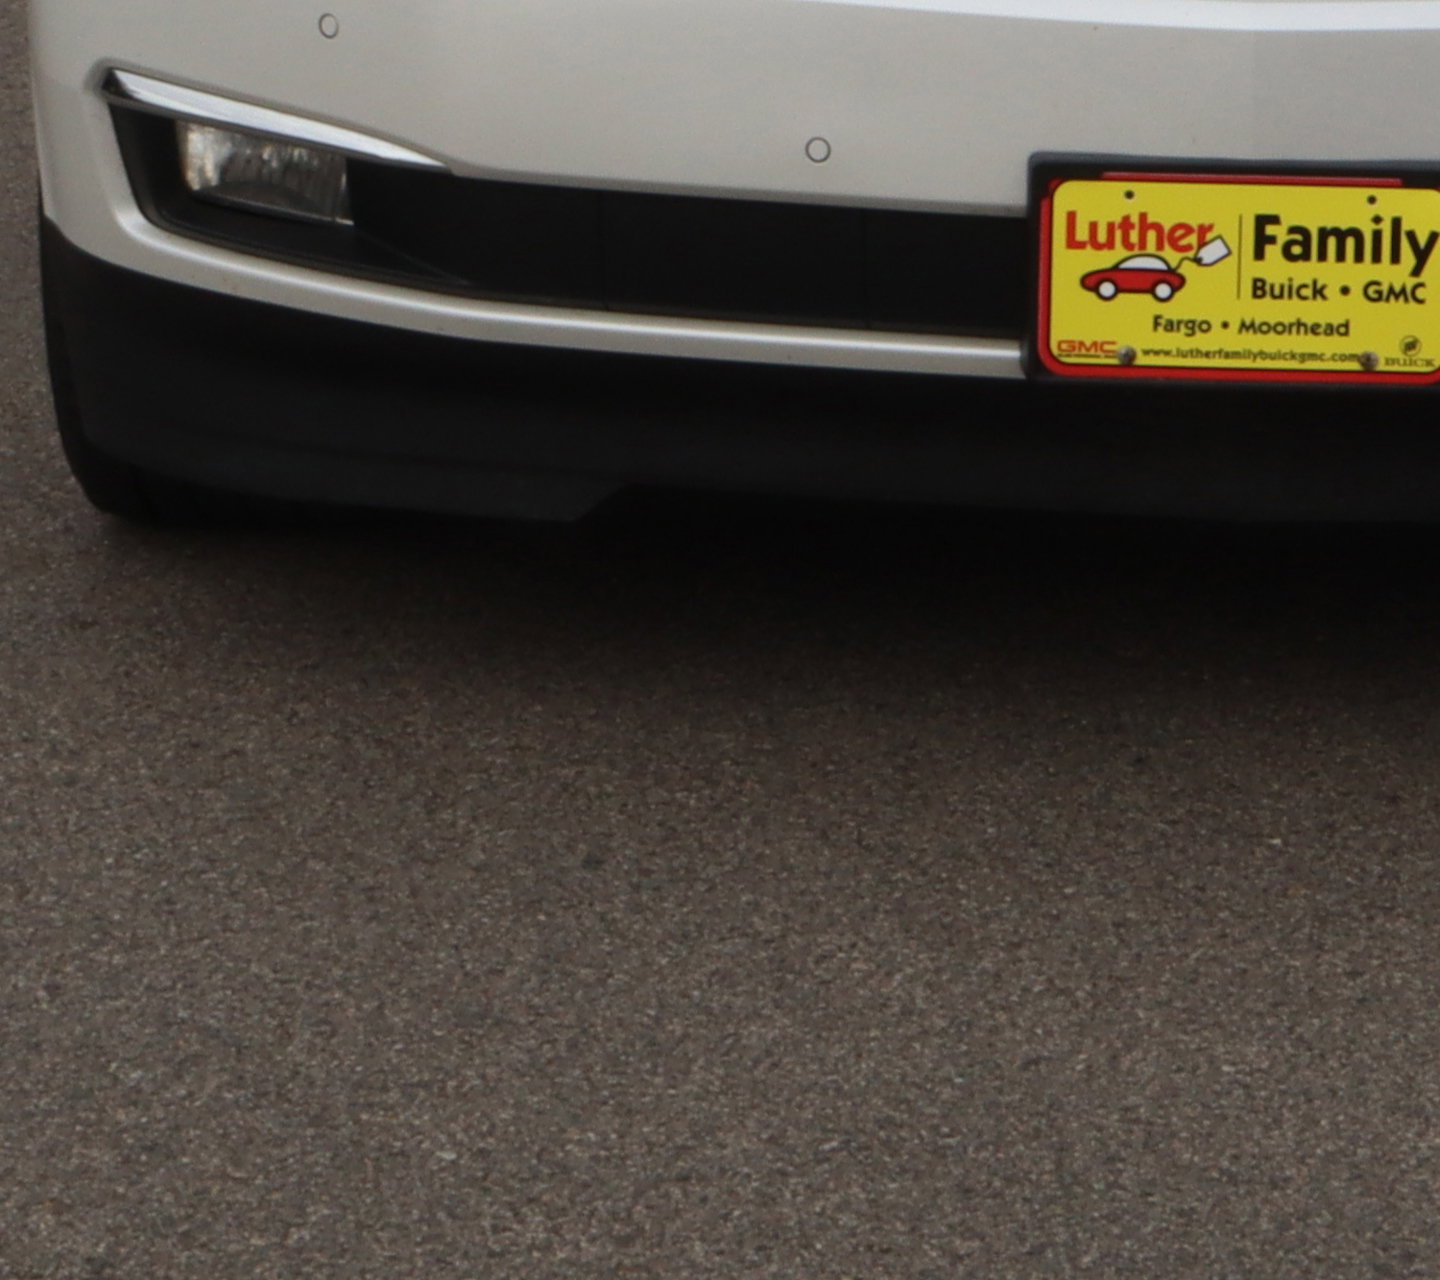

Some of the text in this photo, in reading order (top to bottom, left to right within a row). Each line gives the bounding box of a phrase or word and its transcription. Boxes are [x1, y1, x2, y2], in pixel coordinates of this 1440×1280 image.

[1065, 210, 1214, 253] Luther
[1253, 214, 1440, 278] Family
[1252, 277, 1426, 304] Buick GMC
[1152, 314, 1350, 337] Fargo Moorhead
[1057, 340, 1117, 354] GMC
[1384, 357, 1436, 368] BUICK
